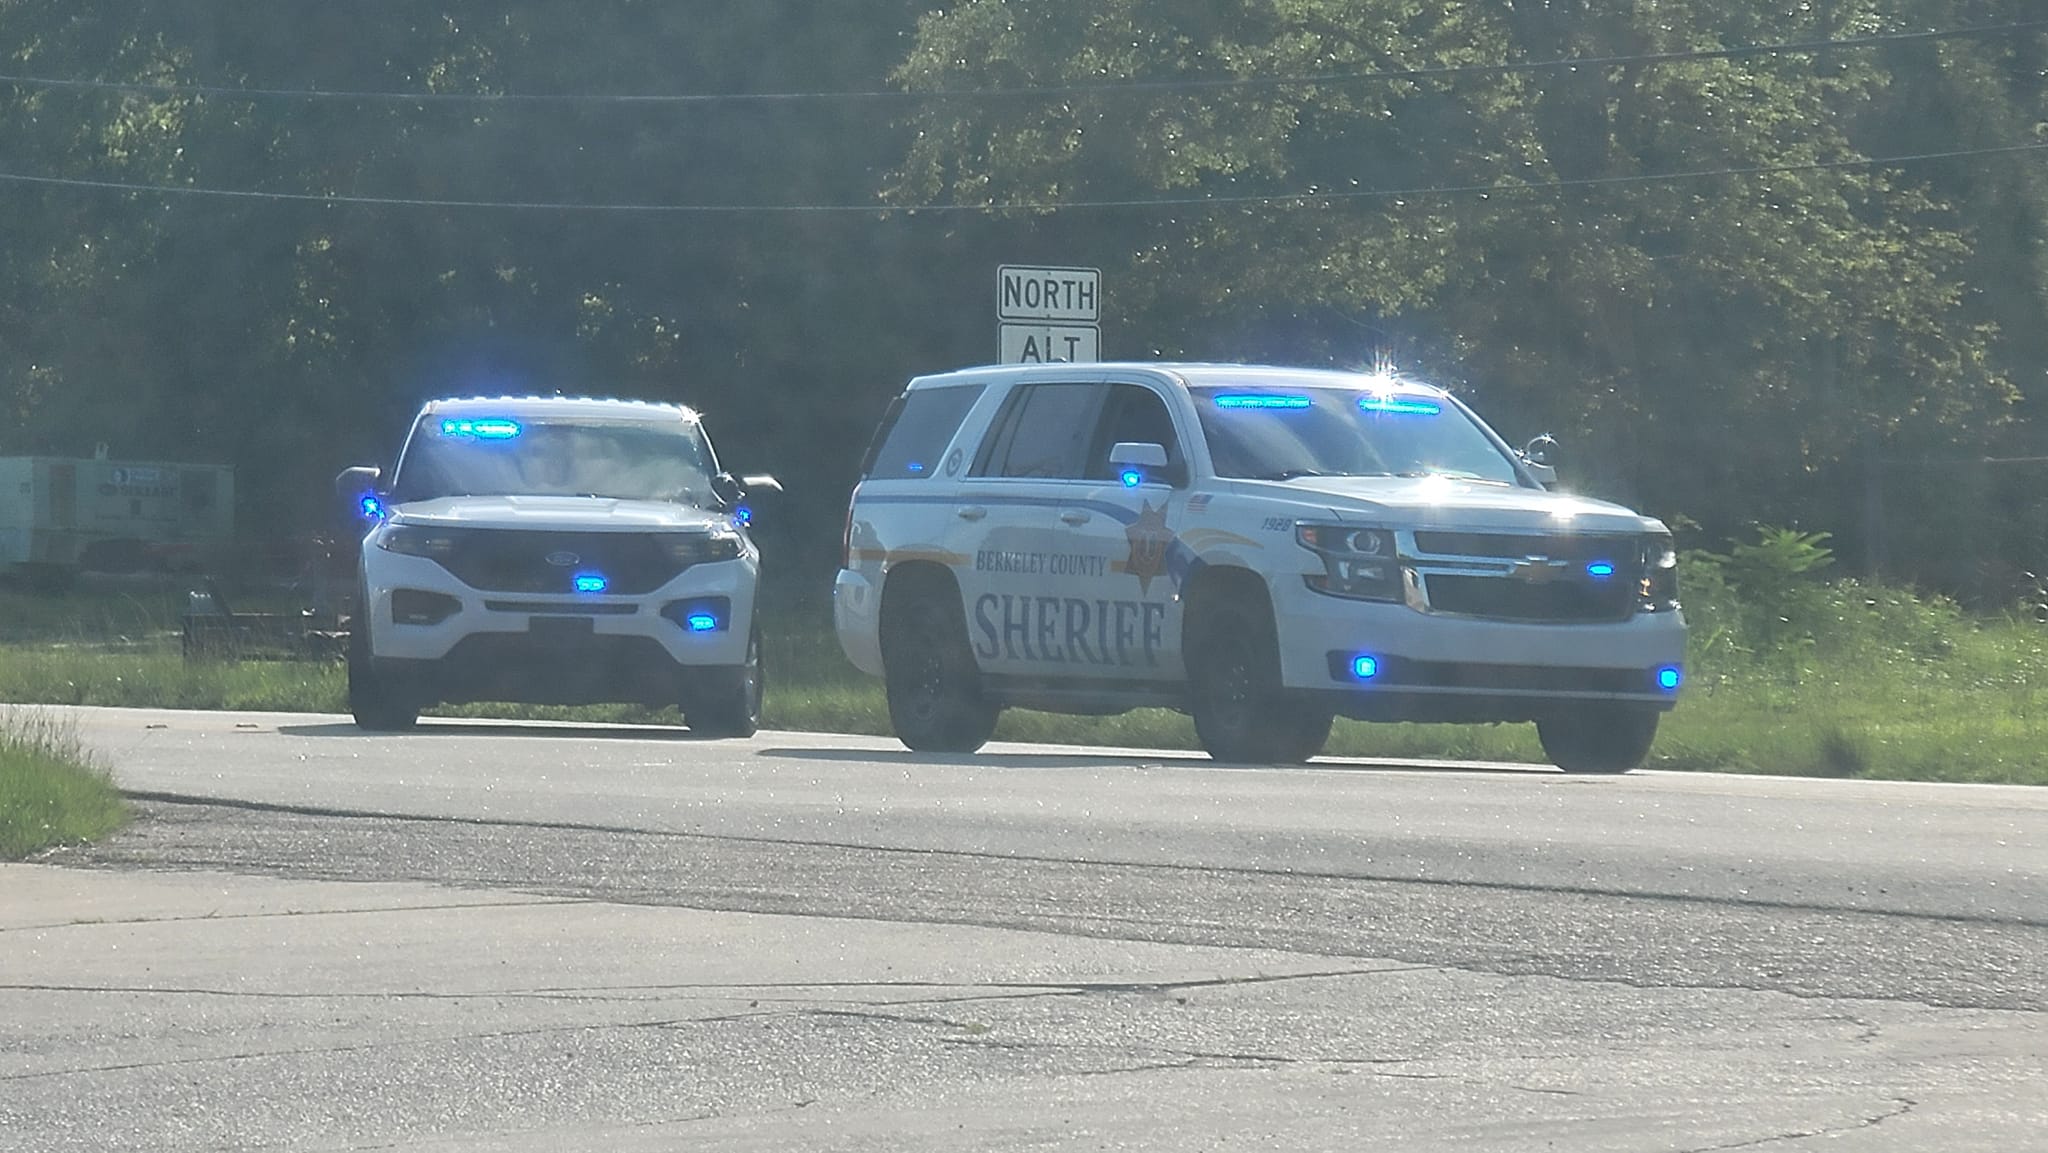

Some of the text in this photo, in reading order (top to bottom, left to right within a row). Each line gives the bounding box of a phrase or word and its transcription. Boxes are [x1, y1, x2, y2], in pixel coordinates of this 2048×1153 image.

[1004, 275, 1094, 310] NORTH
[975, 549, 1109, 577] BERKELEY COUNTY
[974, 593, 1165, 668] SHERIFF
